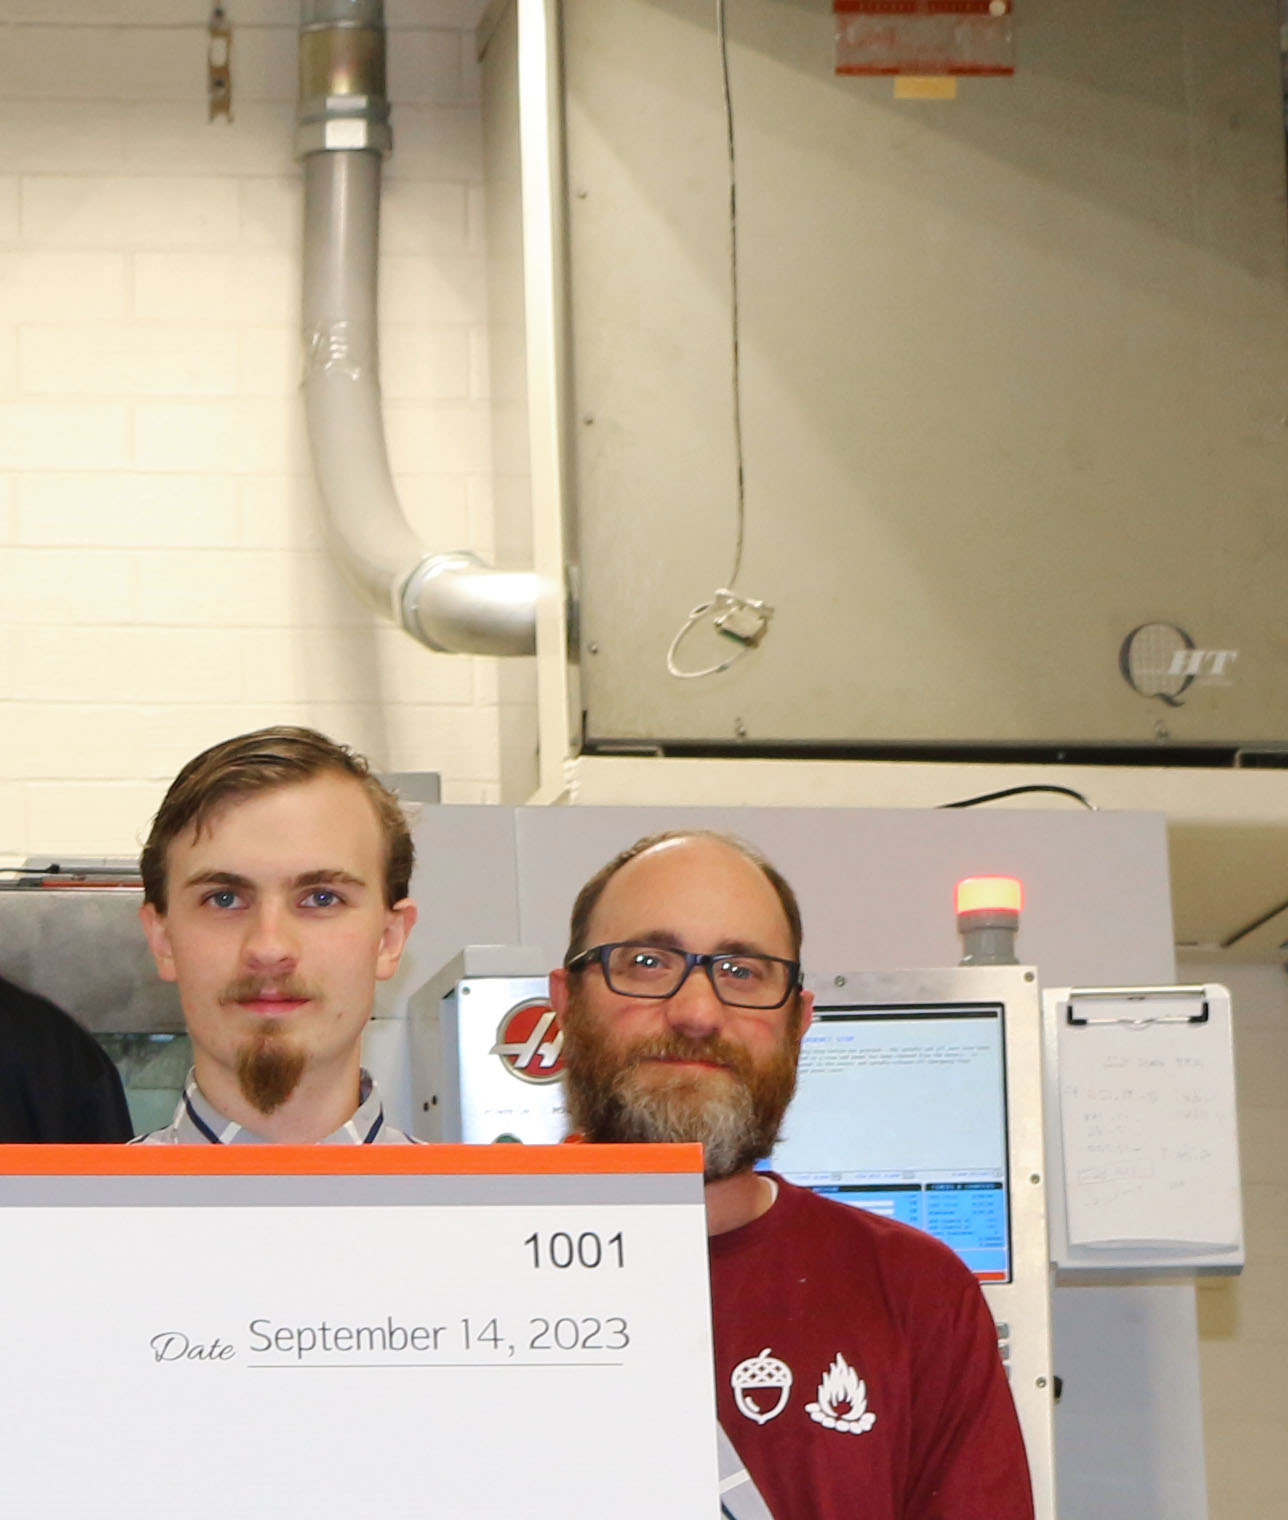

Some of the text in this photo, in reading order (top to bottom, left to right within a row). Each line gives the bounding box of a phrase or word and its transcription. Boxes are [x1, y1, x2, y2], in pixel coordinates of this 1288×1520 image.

[523, 1231, 625, 1270] 1001
[149, 1316, 631, 1363] Date September 14, 2023
